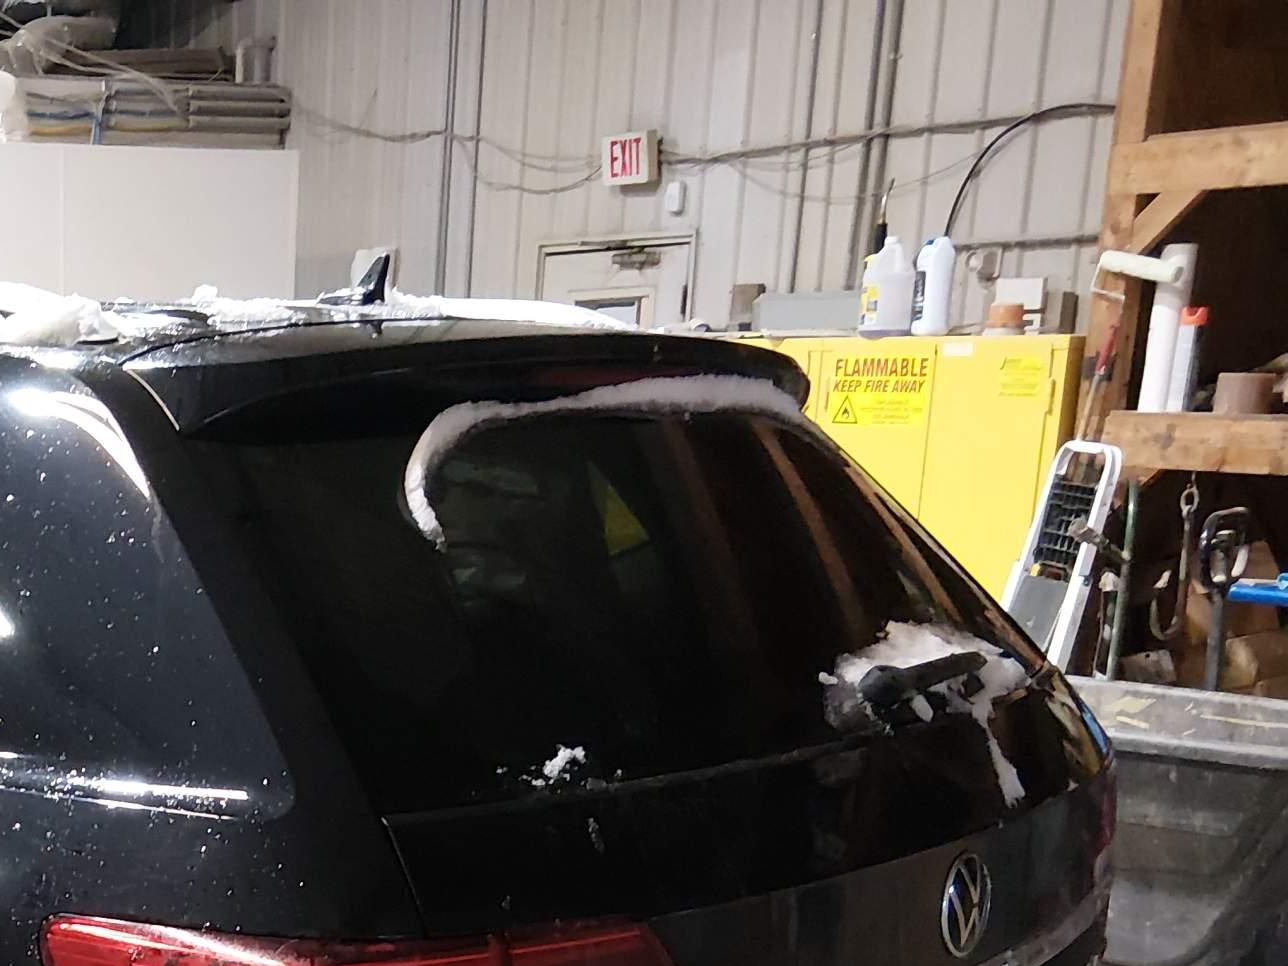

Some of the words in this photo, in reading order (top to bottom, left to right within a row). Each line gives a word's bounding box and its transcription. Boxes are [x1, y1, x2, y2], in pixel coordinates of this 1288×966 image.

[610, 137, 641, 178] EXIT
[835, 358, 929, 377] FLAMMABLE
[833, 379, 862, 392] KEEP
[864, 379, 890, 392] FIRE
[892, 379, 926, 392] AWAY
